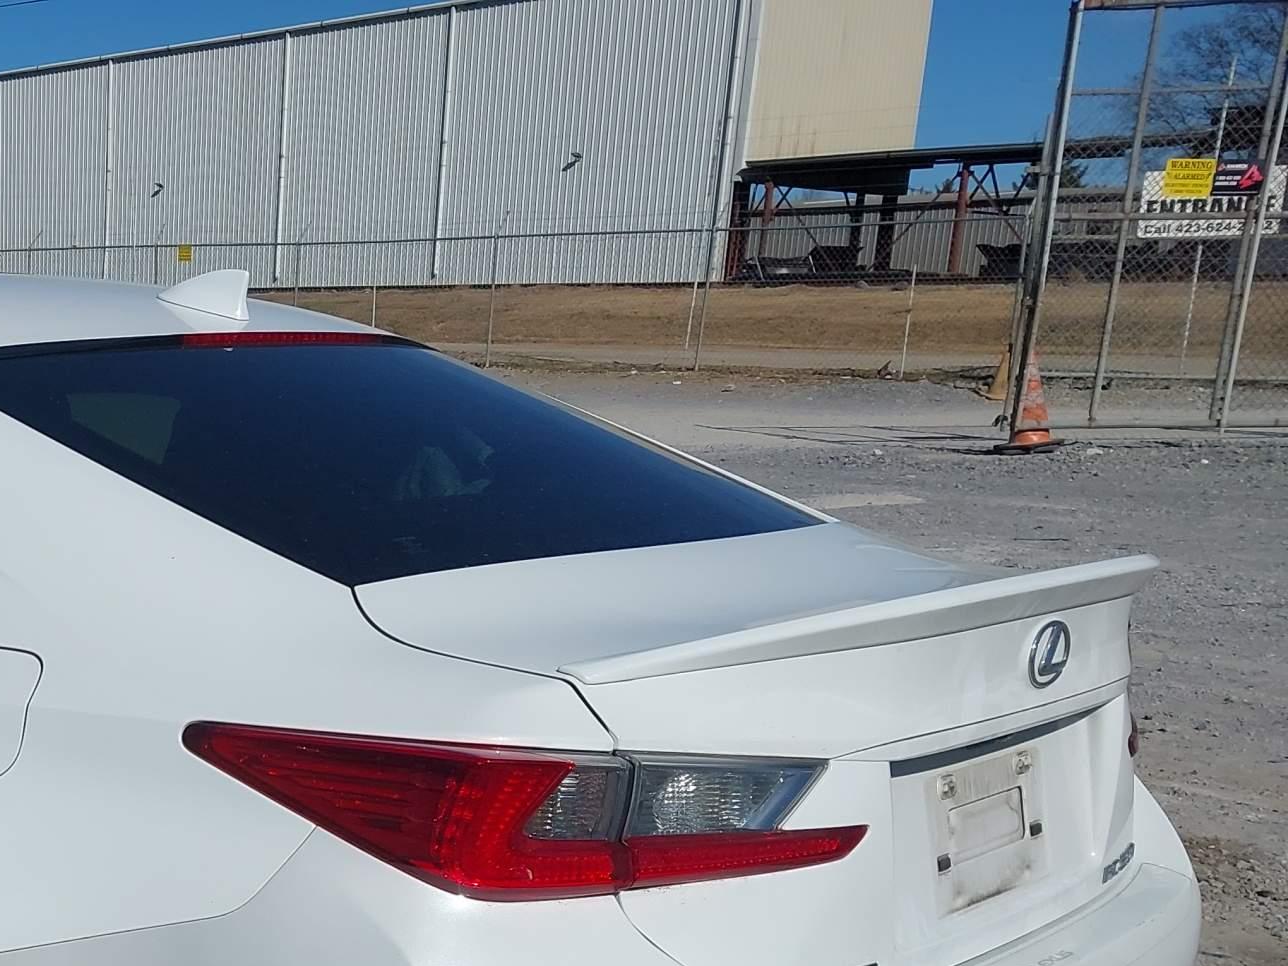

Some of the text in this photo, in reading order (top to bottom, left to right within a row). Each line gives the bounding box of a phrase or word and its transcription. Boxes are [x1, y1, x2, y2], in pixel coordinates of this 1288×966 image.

[1171, 160, 1213, 169] WARNING
[1146, 195, 1277, 213] ENTRANE
[1144, 220, 1273, 234] Call 423-624-22
